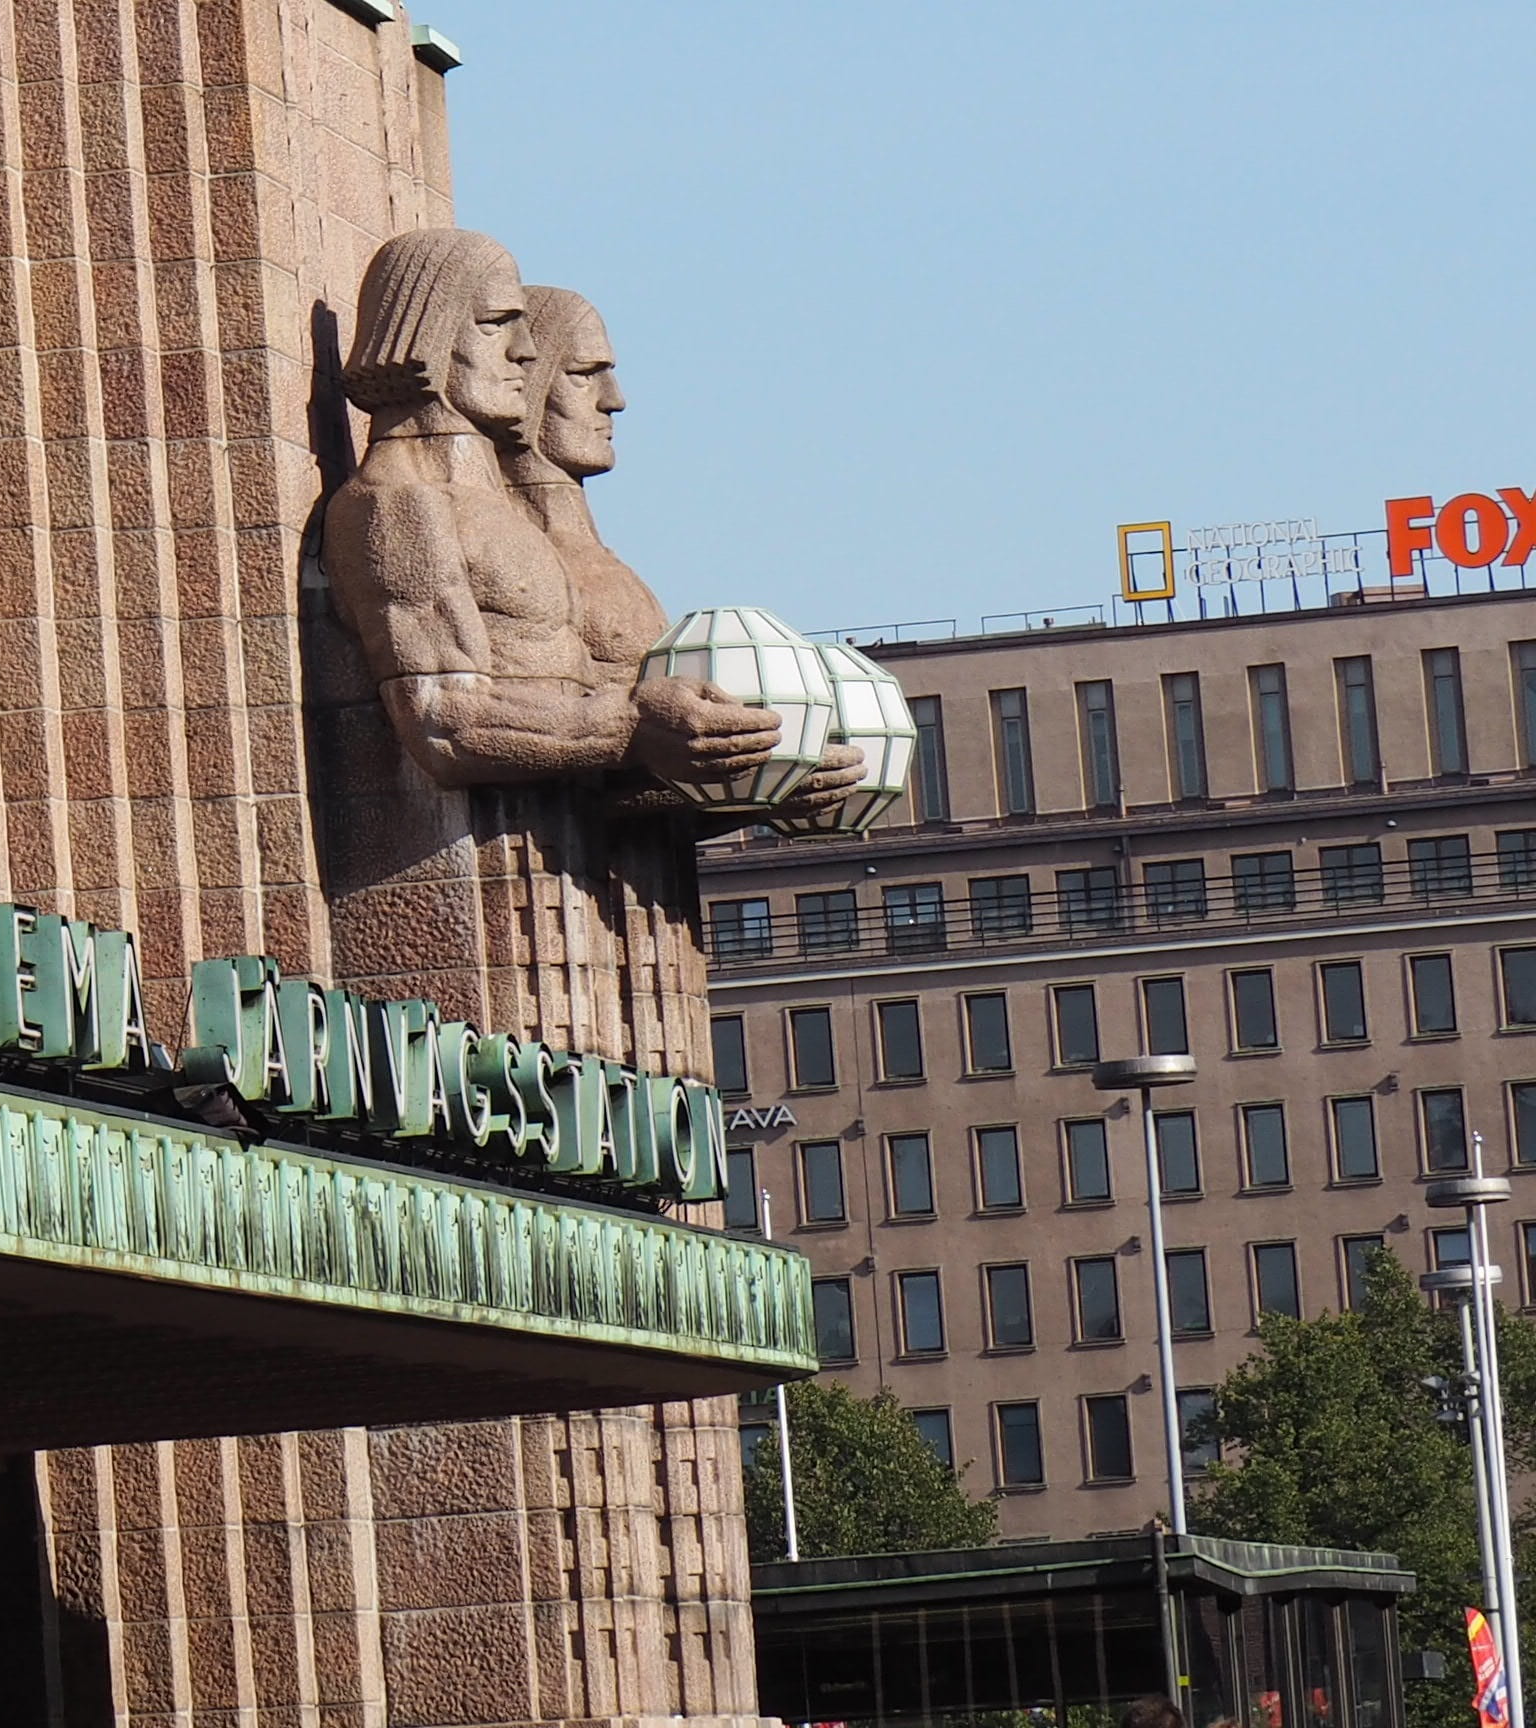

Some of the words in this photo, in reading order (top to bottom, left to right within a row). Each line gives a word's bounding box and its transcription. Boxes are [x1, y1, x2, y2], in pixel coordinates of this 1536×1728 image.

[1186, 517, 1325, 552] NATIONAL
[1385, 487, 1536, 577] FOX
[1185, 545, 1365, 587] GEOGRAPHIC
[182, 955, 728, 1202] JÄRNVÄGSSTATION
